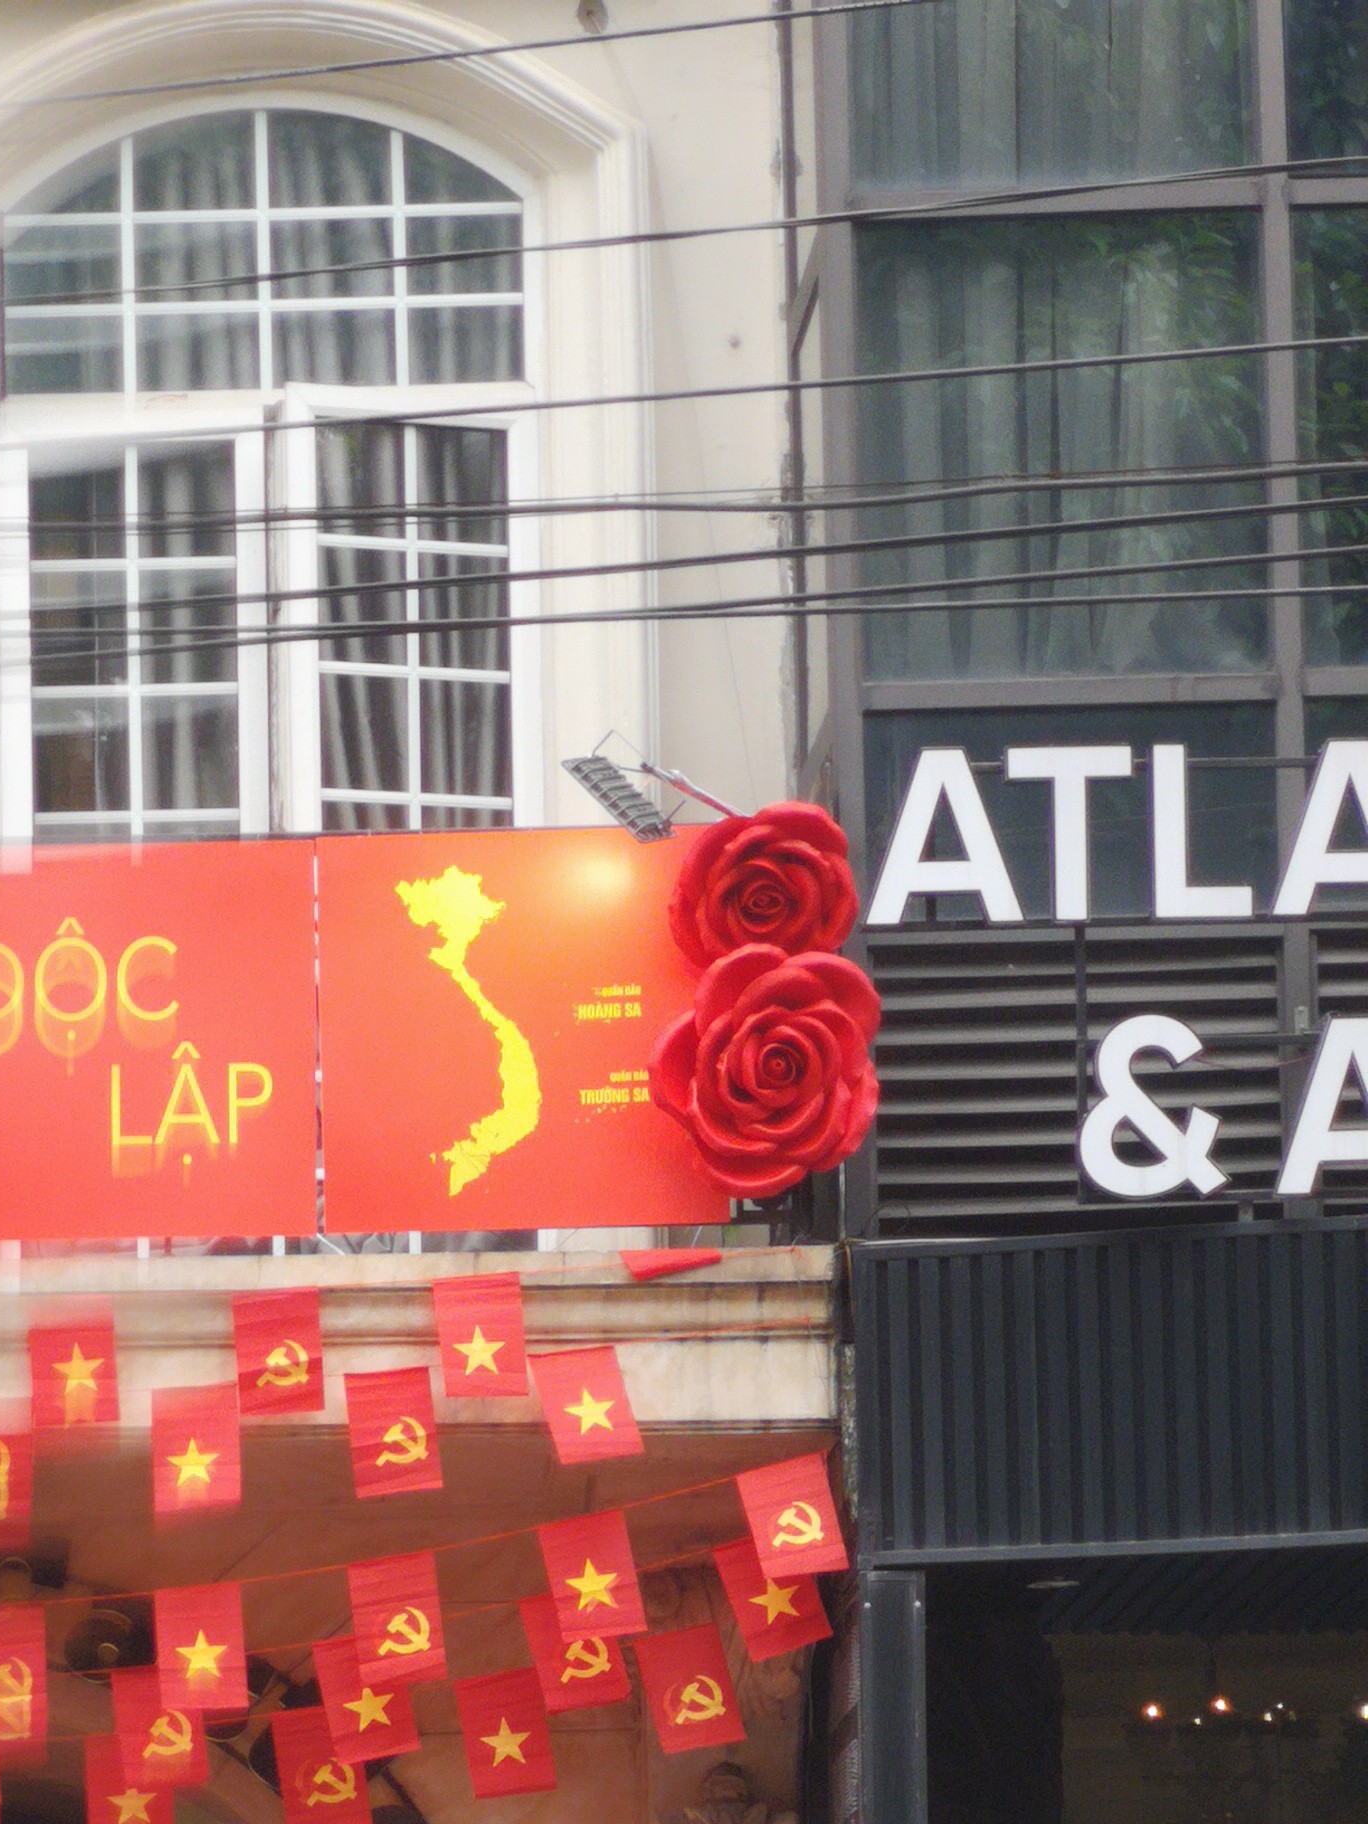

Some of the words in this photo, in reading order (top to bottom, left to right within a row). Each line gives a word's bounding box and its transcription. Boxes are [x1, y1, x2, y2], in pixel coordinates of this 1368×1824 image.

[864, 738, 1368, 926] ATLA
[625, 1002, 641, 1017] SA
[110, 1040, 274, 1168] LẬP
[633, 1087, 650, 1102] SA
[1078, 1013, 1232, 1198] &
[1274, 1013, 1368, 1197] A
